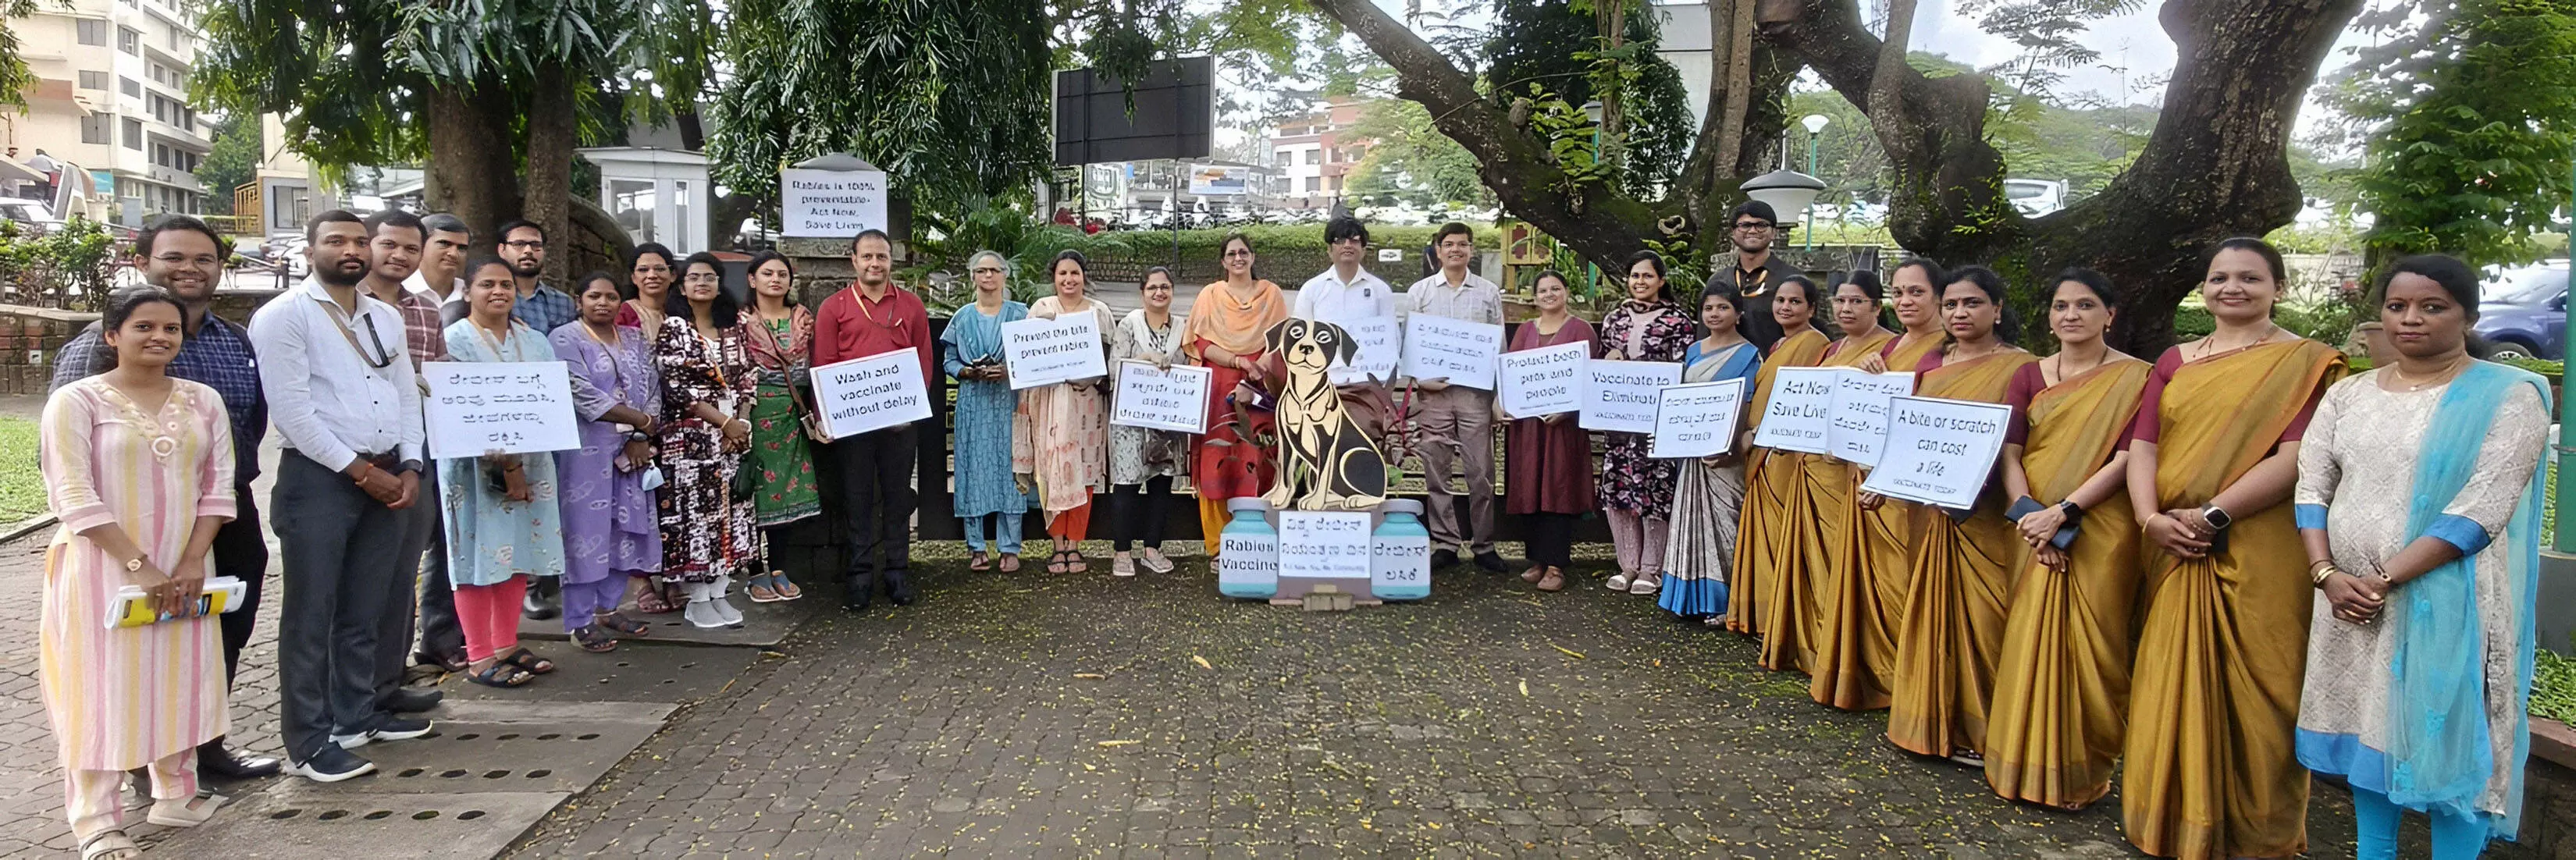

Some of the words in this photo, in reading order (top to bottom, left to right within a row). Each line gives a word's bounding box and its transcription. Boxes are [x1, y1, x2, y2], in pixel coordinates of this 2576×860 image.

[810, 208, 828, 216] Act
[806, 220, 831, 229] Save
[1507, 354, 1550, 368] Protect
[1553, 350, 1581, 363] both
[835, 369, 871, 385] Wash
[875, 364, 899, 377] and
[1521, 372, 1546, 386] pets
[1550, 368, 1573, 379] and
[1592, 371, 1653, 386] Vaccinate
[1656, 376, 1670, 386] to
[840, 381, 902, 401] vaccinate
[1526, 386, 1567, 401] people
[1783, 381, 1804, 394] Act
[832, 402, 880, 420] without
[884, 395, 917, 410] delay
[1772, 401, 1800, 418] Save
[1898, 408, 1906, 424] A
[1909, 410, 1931, 427] bite
[1934, 416, 1948, 428] or
[1950, 418, 1997, 435] scratch
[1917, 438, 1938, 452] can
[1941, 442, 1968, 456] cost
[1916, 461, 1924, 473] a
[1926, 460, 1946, 477] life
[1225, 539, 1274, 553] Rabies
[1374, 542, 1427, 557] ರೇಬೀಸ್
[1221, 558, 1279, 571] Vaccine
